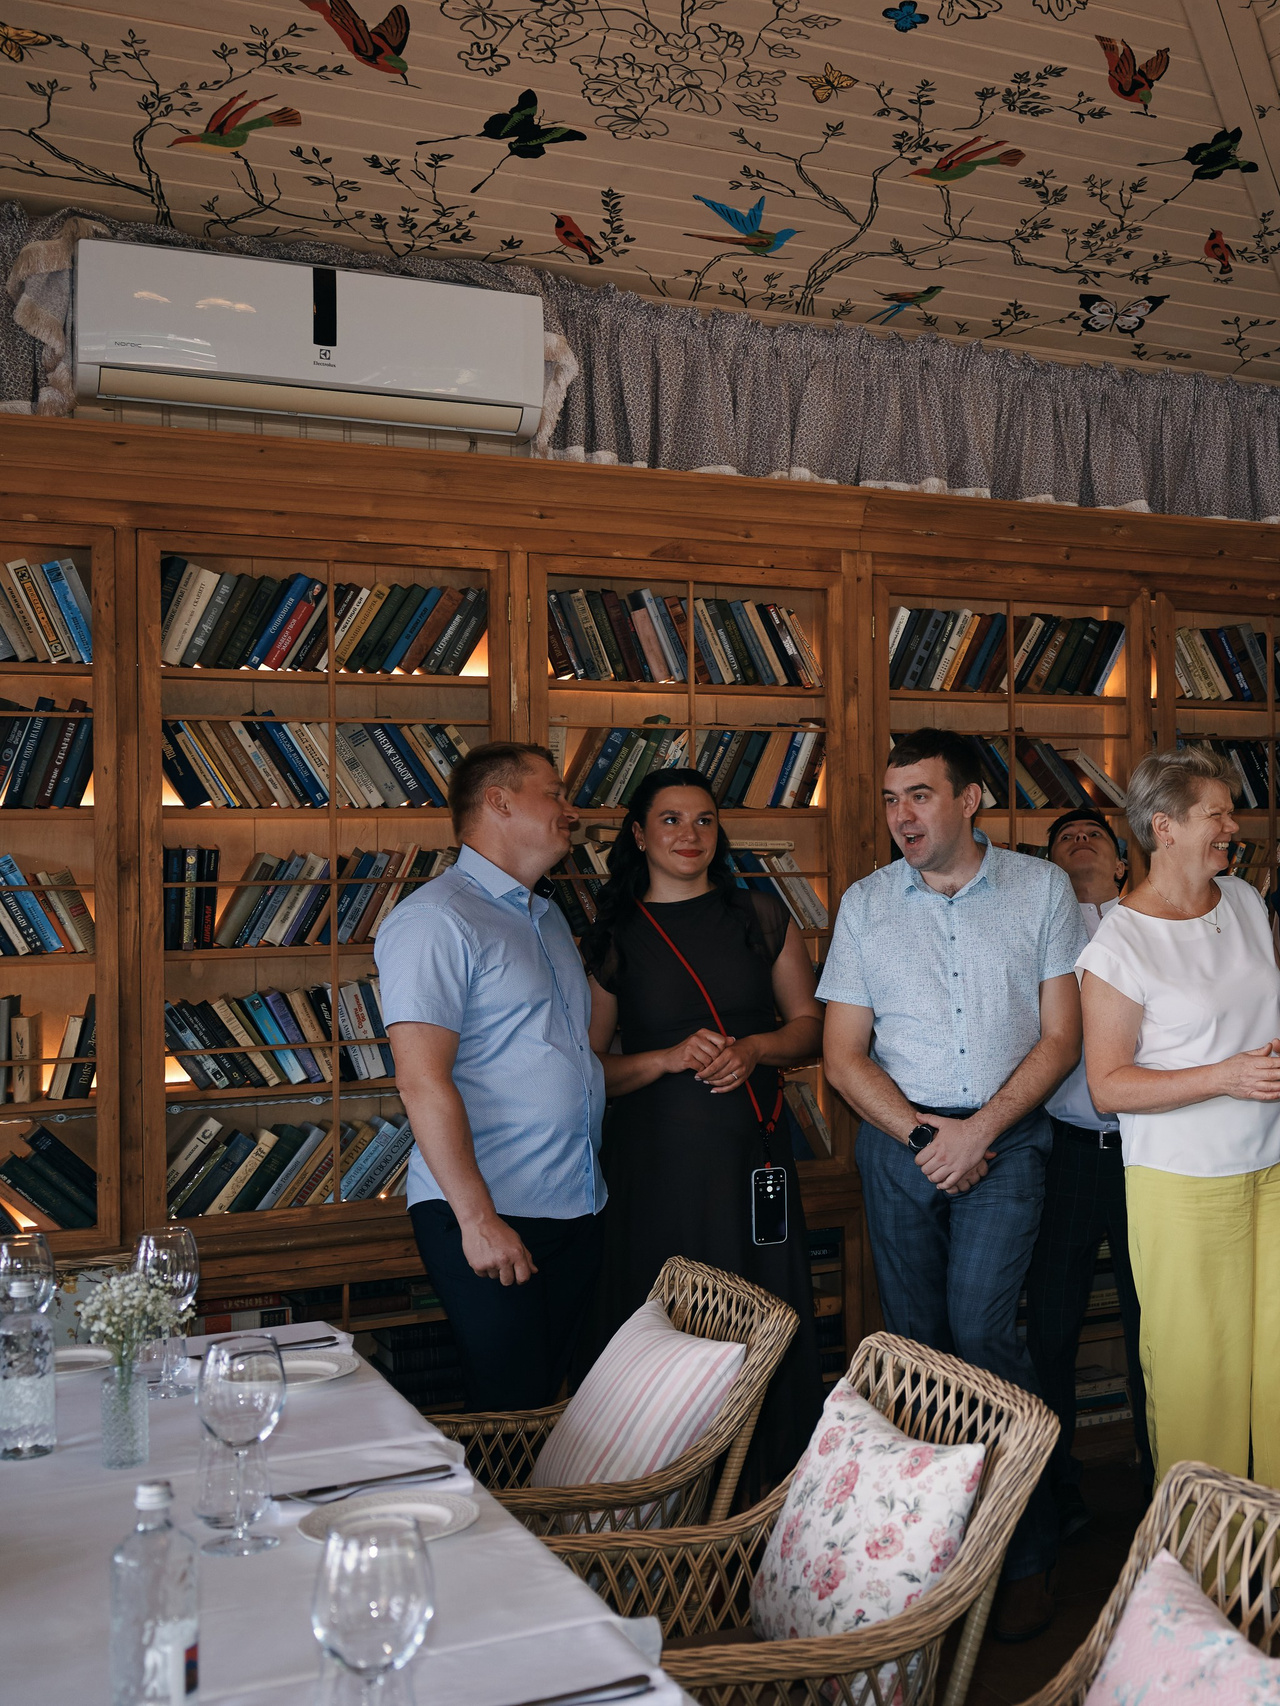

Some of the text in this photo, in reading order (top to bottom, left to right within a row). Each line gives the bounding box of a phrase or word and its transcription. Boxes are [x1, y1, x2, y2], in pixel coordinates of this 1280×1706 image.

[312, 360, 336, 368] Electrolux
[7, 586, 21, 609] МИОНА
[21, 615, 33, 633] ГОСТИ
[268, 596, 295, 634] СОЦИОЛОГИЯ
[275, 618, 297, 649] НАВЕКИ ТВОЯ
[280, 635, 292, 652] ЭМБЕР
[22, 737, 35, 759] ОХОТА
[29, 728, 39, 738] НА
[372, 727, 418, 791] НА ДОРОГЕ ЖИЗНИ
[203, 905, 211, 942] ШИБУМИ
[352, 1007, 363, 1029] Солдаты
[353, 993, 363, 1012] оружия
[342, 1023, 357, 1054] AMERAN
[78, 1048, 95, 1085] ВИКТР
[343, 1137, 367, 1165] ГРИН
[354, 1127, 413, 1200] ТВОРИ СВОЮ СУДЬБУ
